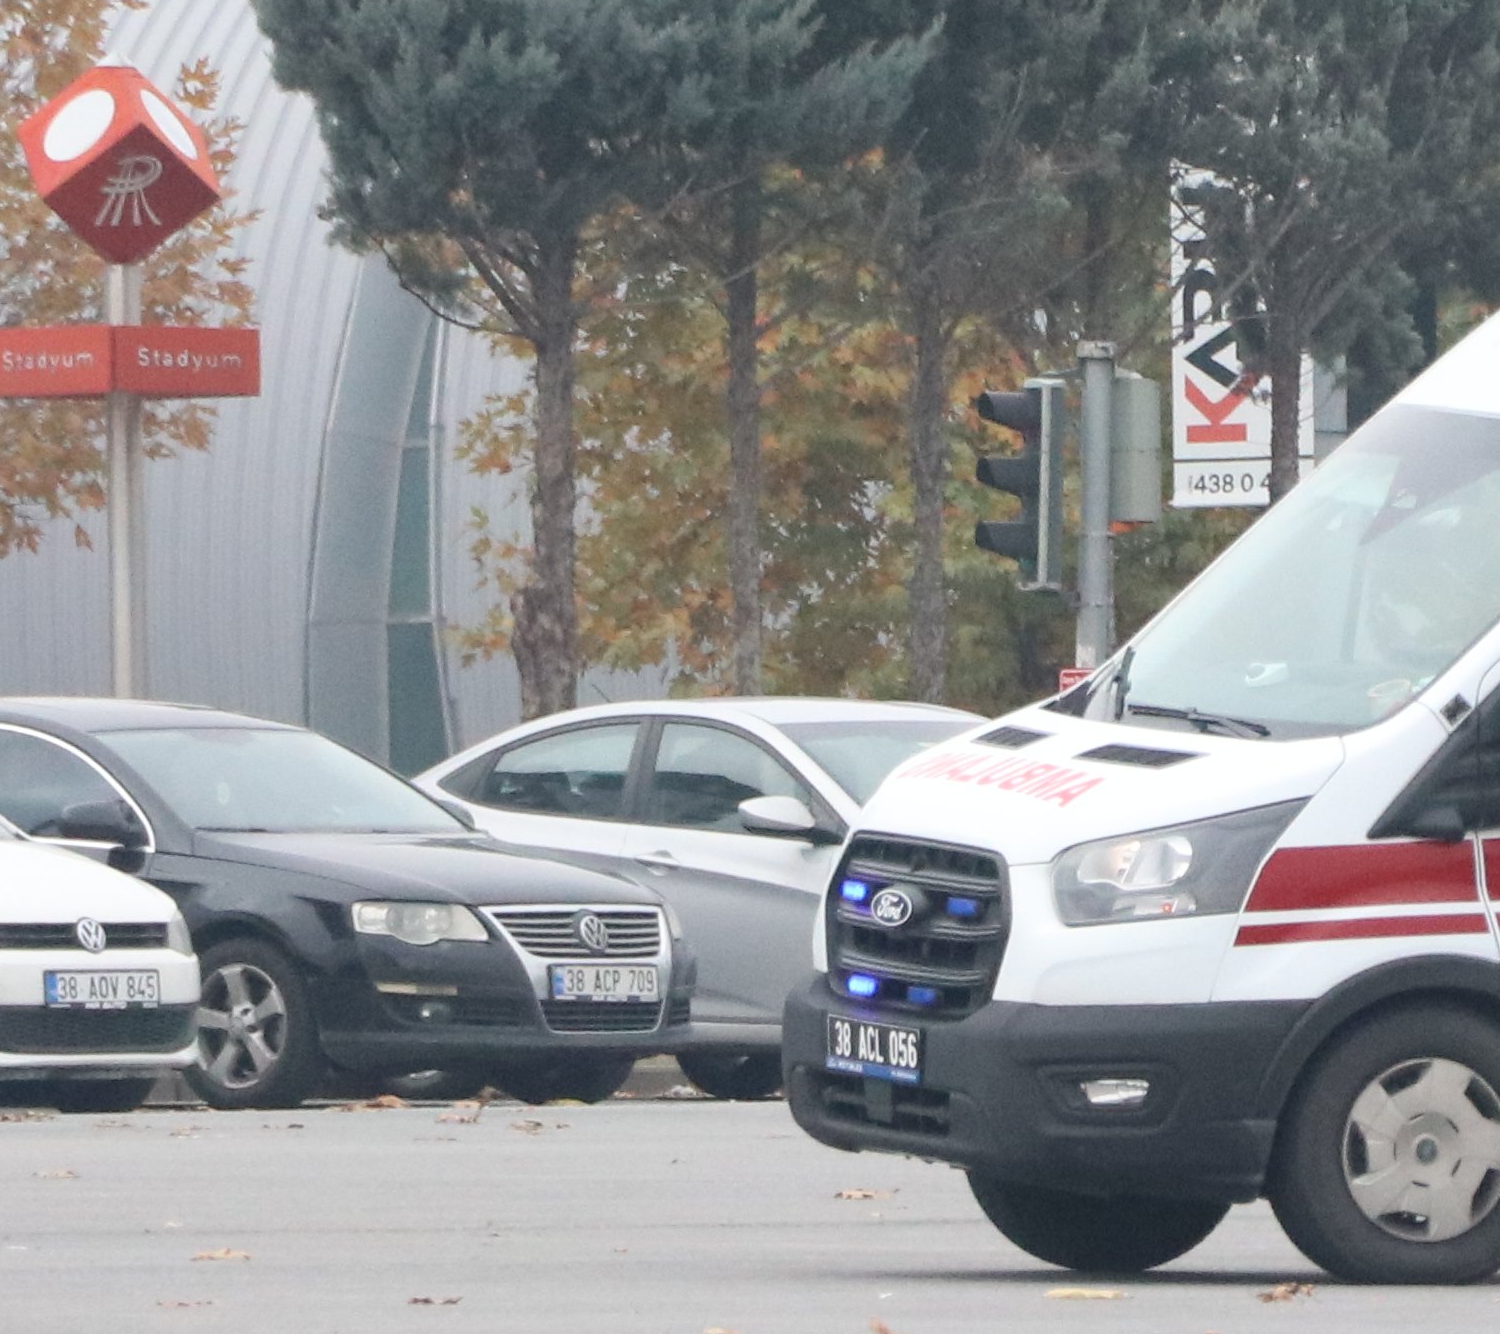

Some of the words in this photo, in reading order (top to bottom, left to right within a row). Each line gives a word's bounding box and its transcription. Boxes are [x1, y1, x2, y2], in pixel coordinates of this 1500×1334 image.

[2, 349, 93, 373] Stadyum
[137, 347, 242, 371] Stadyum
[58, 975, 78, 999] 38
[126, 975, 155, 999] 845
[566, 969, 585, 992] 38
[594, 969, 621, 992] ACP
[628, 969, 654, 992] 709
[834, 1020, 852, 1058] 38
[858, 1025, 885, 1064] ACL
[889, 1029, 918, 1069] 056
